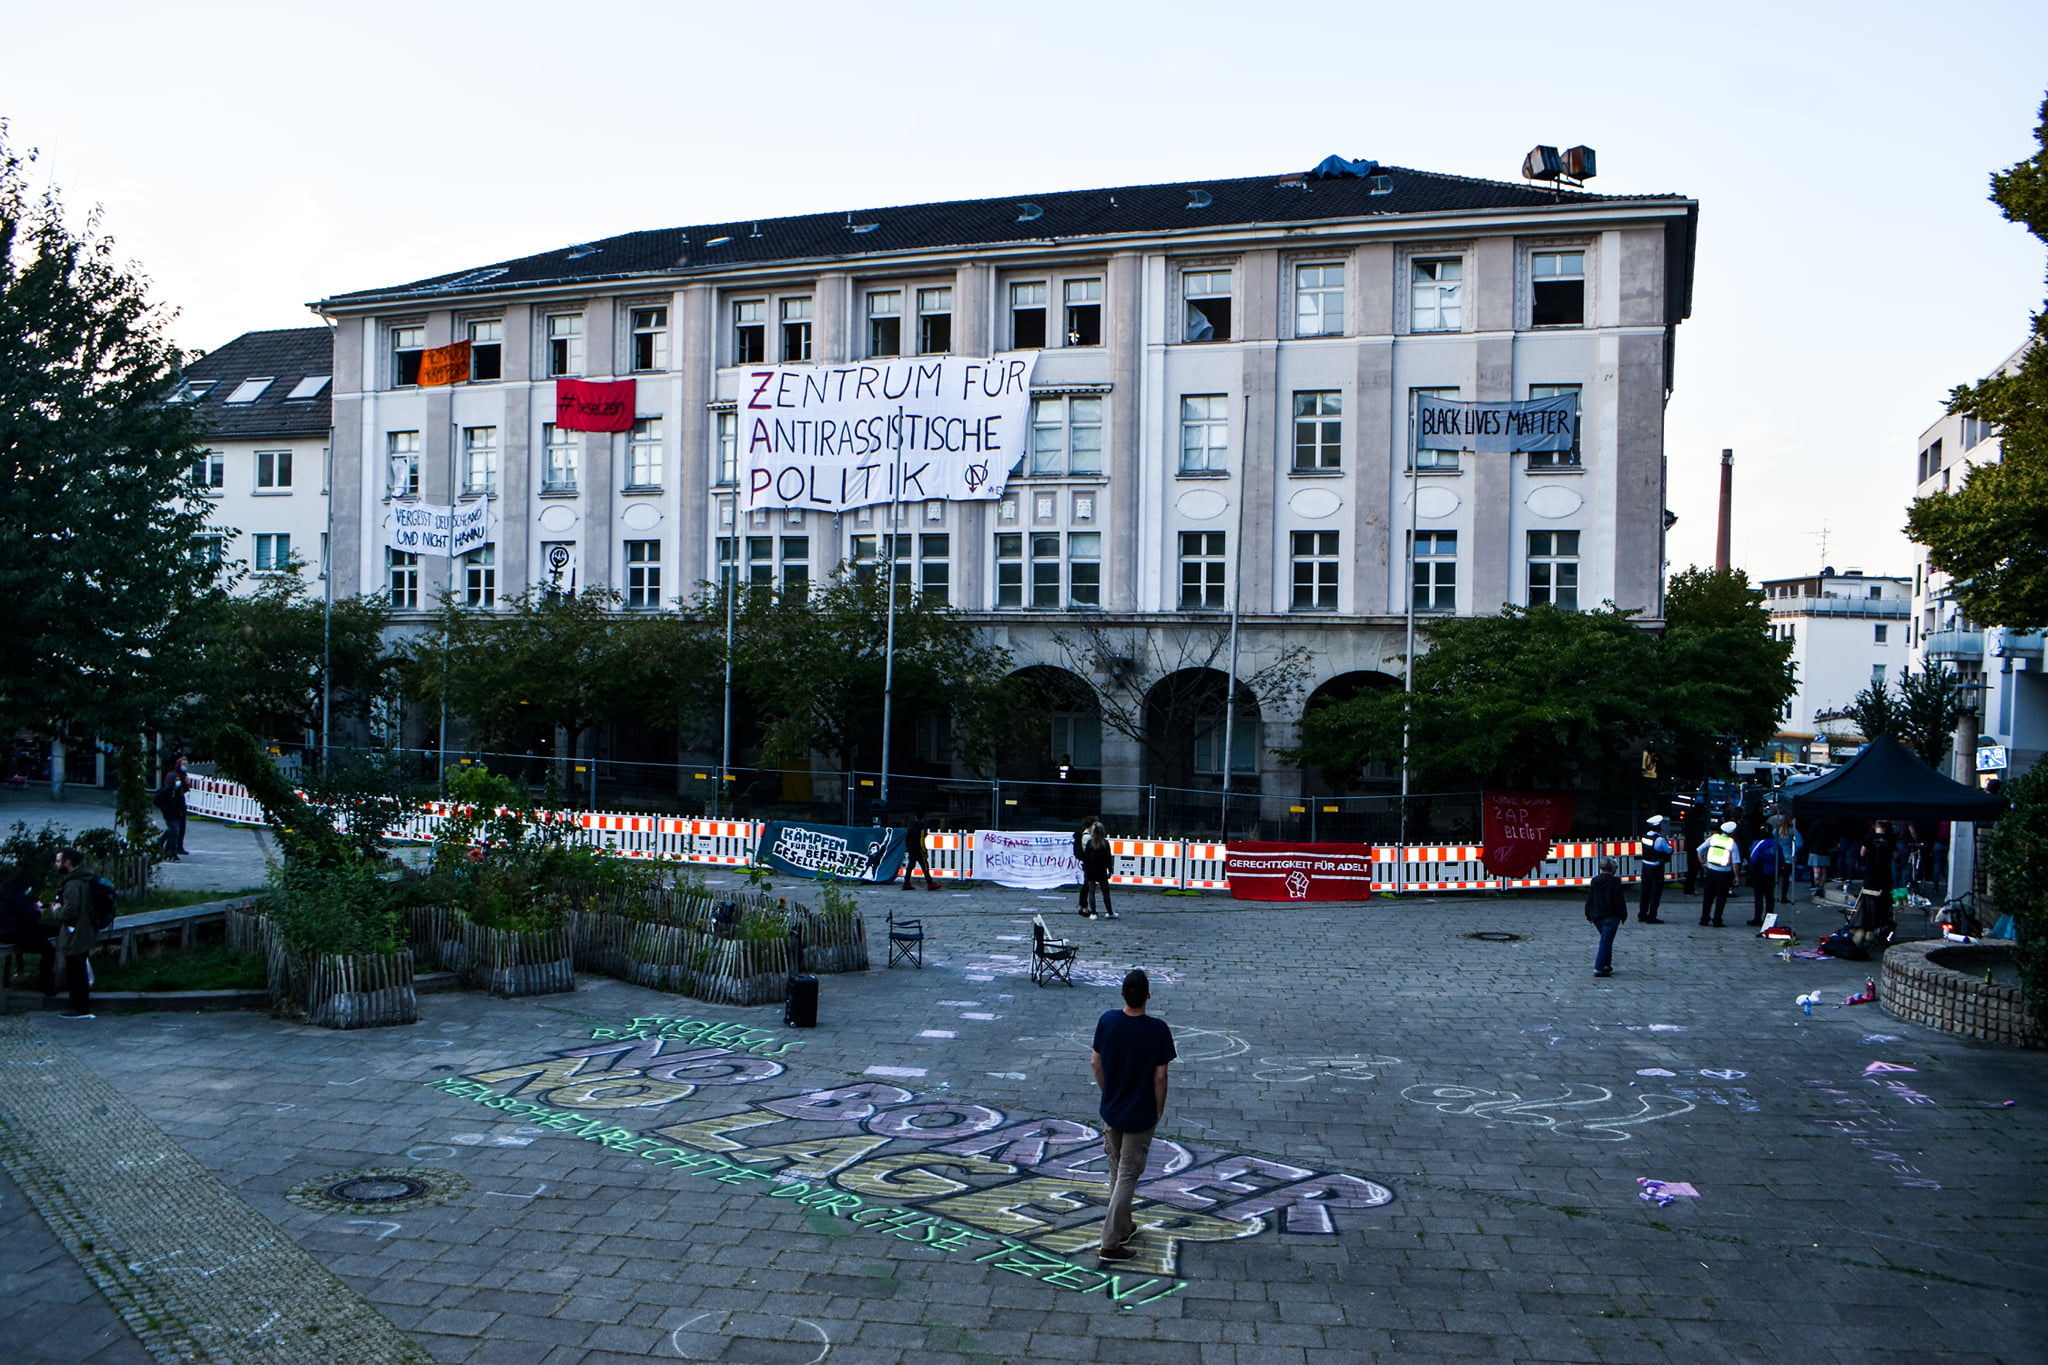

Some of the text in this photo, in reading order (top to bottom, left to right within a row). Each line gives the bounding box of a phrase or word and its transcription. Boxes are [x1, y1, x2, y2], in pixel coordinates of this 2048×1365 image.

[748, 359, 1026, 410] ZENTRUM FÜR
[1423, 408, 1570, 435] BLACK LIVES MATTER
[750, 414, 1002, 456] ANTIRASSISTISCHE
[750, 462, 931, 506] POLITIK
[396, 507, 432, 526] VERGESST
[397, 526, 484, 548] UND NICHT HANAU
[783, 828, 846, 851] KÄMPFEN
[791, 842, 807, 850] FÜR
[984, 832, 1030, 848] ABSTAND
[775, 843, 861, 877] GESELLSCHAFT
[806, 849, 867, 869] BEFREITE
[986, 851, 1019, 868] KEINE
[1229, 859, 1368, 872] GERECHTIGKEIT FÜR ADEL!
[626, 1016, 773, 1040] FIGHT
[552, 1034, 1396, 1235] NO BORDER
[459, 1055, 1268, 1278] NO LAGER
[423, 1077, 1188, 1312] MENSCHENRECHTE DURCHSETZEN!
